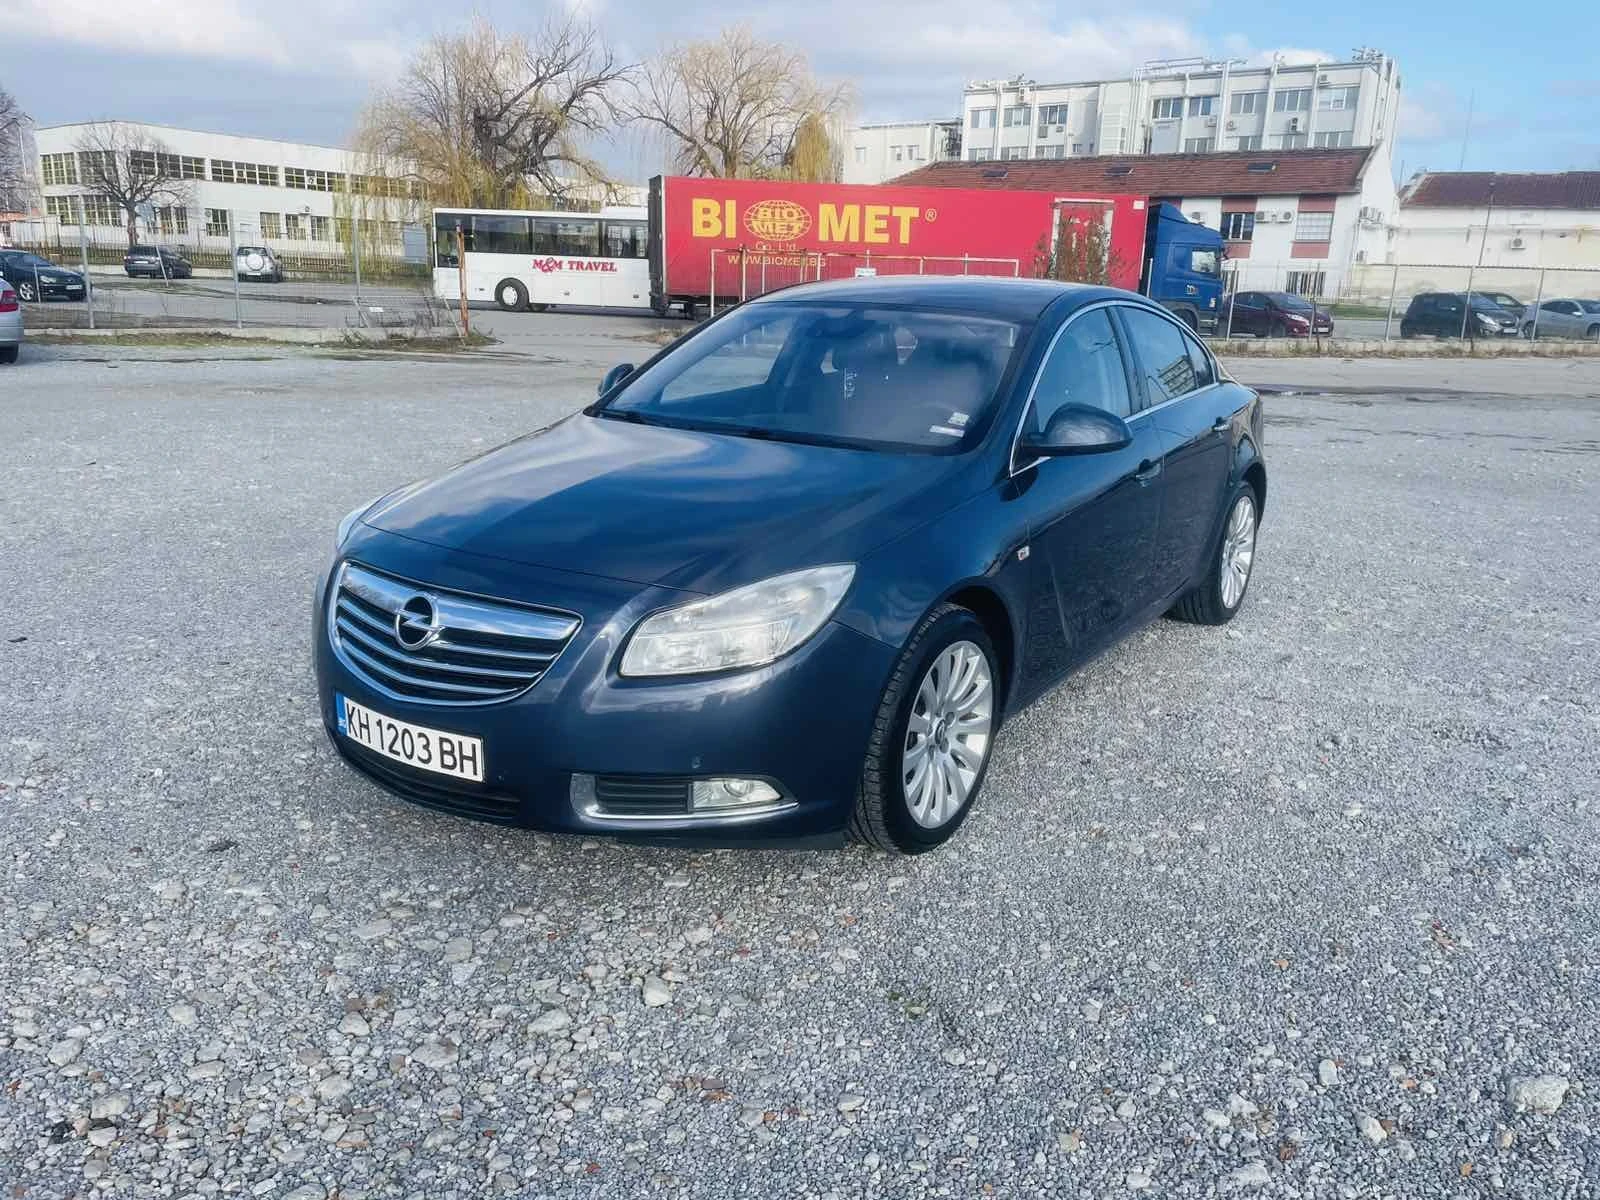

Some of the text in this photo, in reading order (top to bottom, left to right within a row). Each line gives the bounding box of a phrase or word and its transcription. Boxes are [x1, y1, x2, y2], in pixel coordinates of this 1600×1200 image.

[692, 198, 737, 239] BI
[532, 257, 618, 273] M&M TRAVEL
[346, 702, 478, 776] KH 1203 BH
